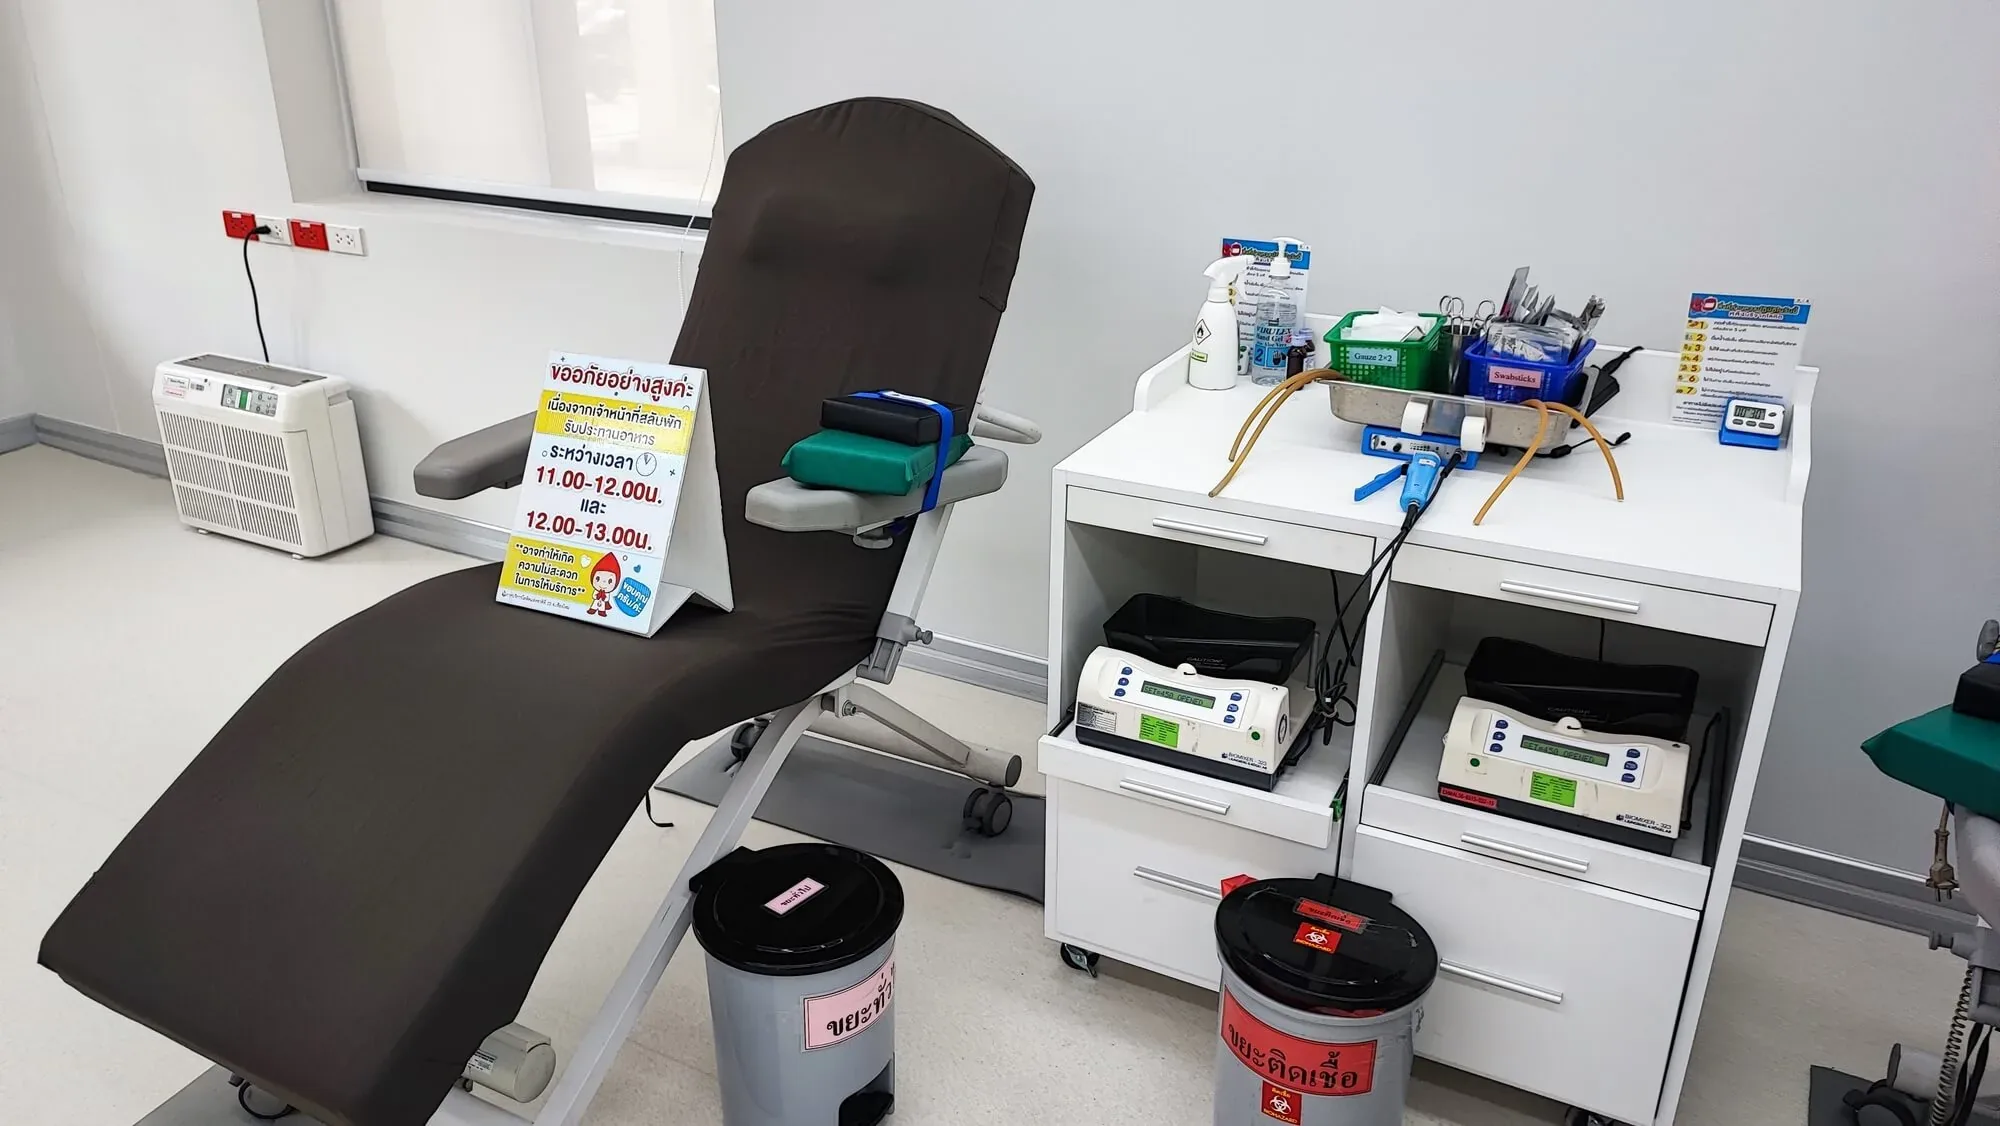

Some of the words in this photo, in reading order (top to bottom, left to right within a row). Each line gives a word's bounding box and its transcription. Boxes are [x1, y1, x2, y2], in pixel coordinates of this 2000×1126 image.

[1699, 321, 1705, 329] 1
[1255, 348, 1264, 362] 2
[1354, 352, 1377, 362] Gauze
[1692, 354, 1699, 362] 4
[1494, 371, 1537, 384] Swabsticks
[1690, 364, 1698, 372] 5
[551, 364, 694, 402] ขออภัยอย่างสูงค่ะ
[547, 393, 682, 430] เนื่องจากเจ้าหน้าที่สลับพัก
[564, 419, 656, 447] รับประทานอาหาร
[549, 443, 633, 471] ระหว่างเวลา
[536, 465, 662, 504] 11.00-12.00น.
[580, 498, 607, 514] และ
[526, 510, 653, 551] 12.00-13.00น.
[517, 561, 578, 581] ความไม่สะดวก
[622, 580, 650, 605] ขอบคุณ
[780, 885, 811, 906] ขยะทั่วไป
[1295, 938, 1333, 952] BIOHAZARD
[826, 966, 894, 1037] ขยะทั่ว
[1228, 1022, 1358, 1090] ขยะติดเชื้อ
[1263, 1108, 1298, 1124] BIOHAZARD
